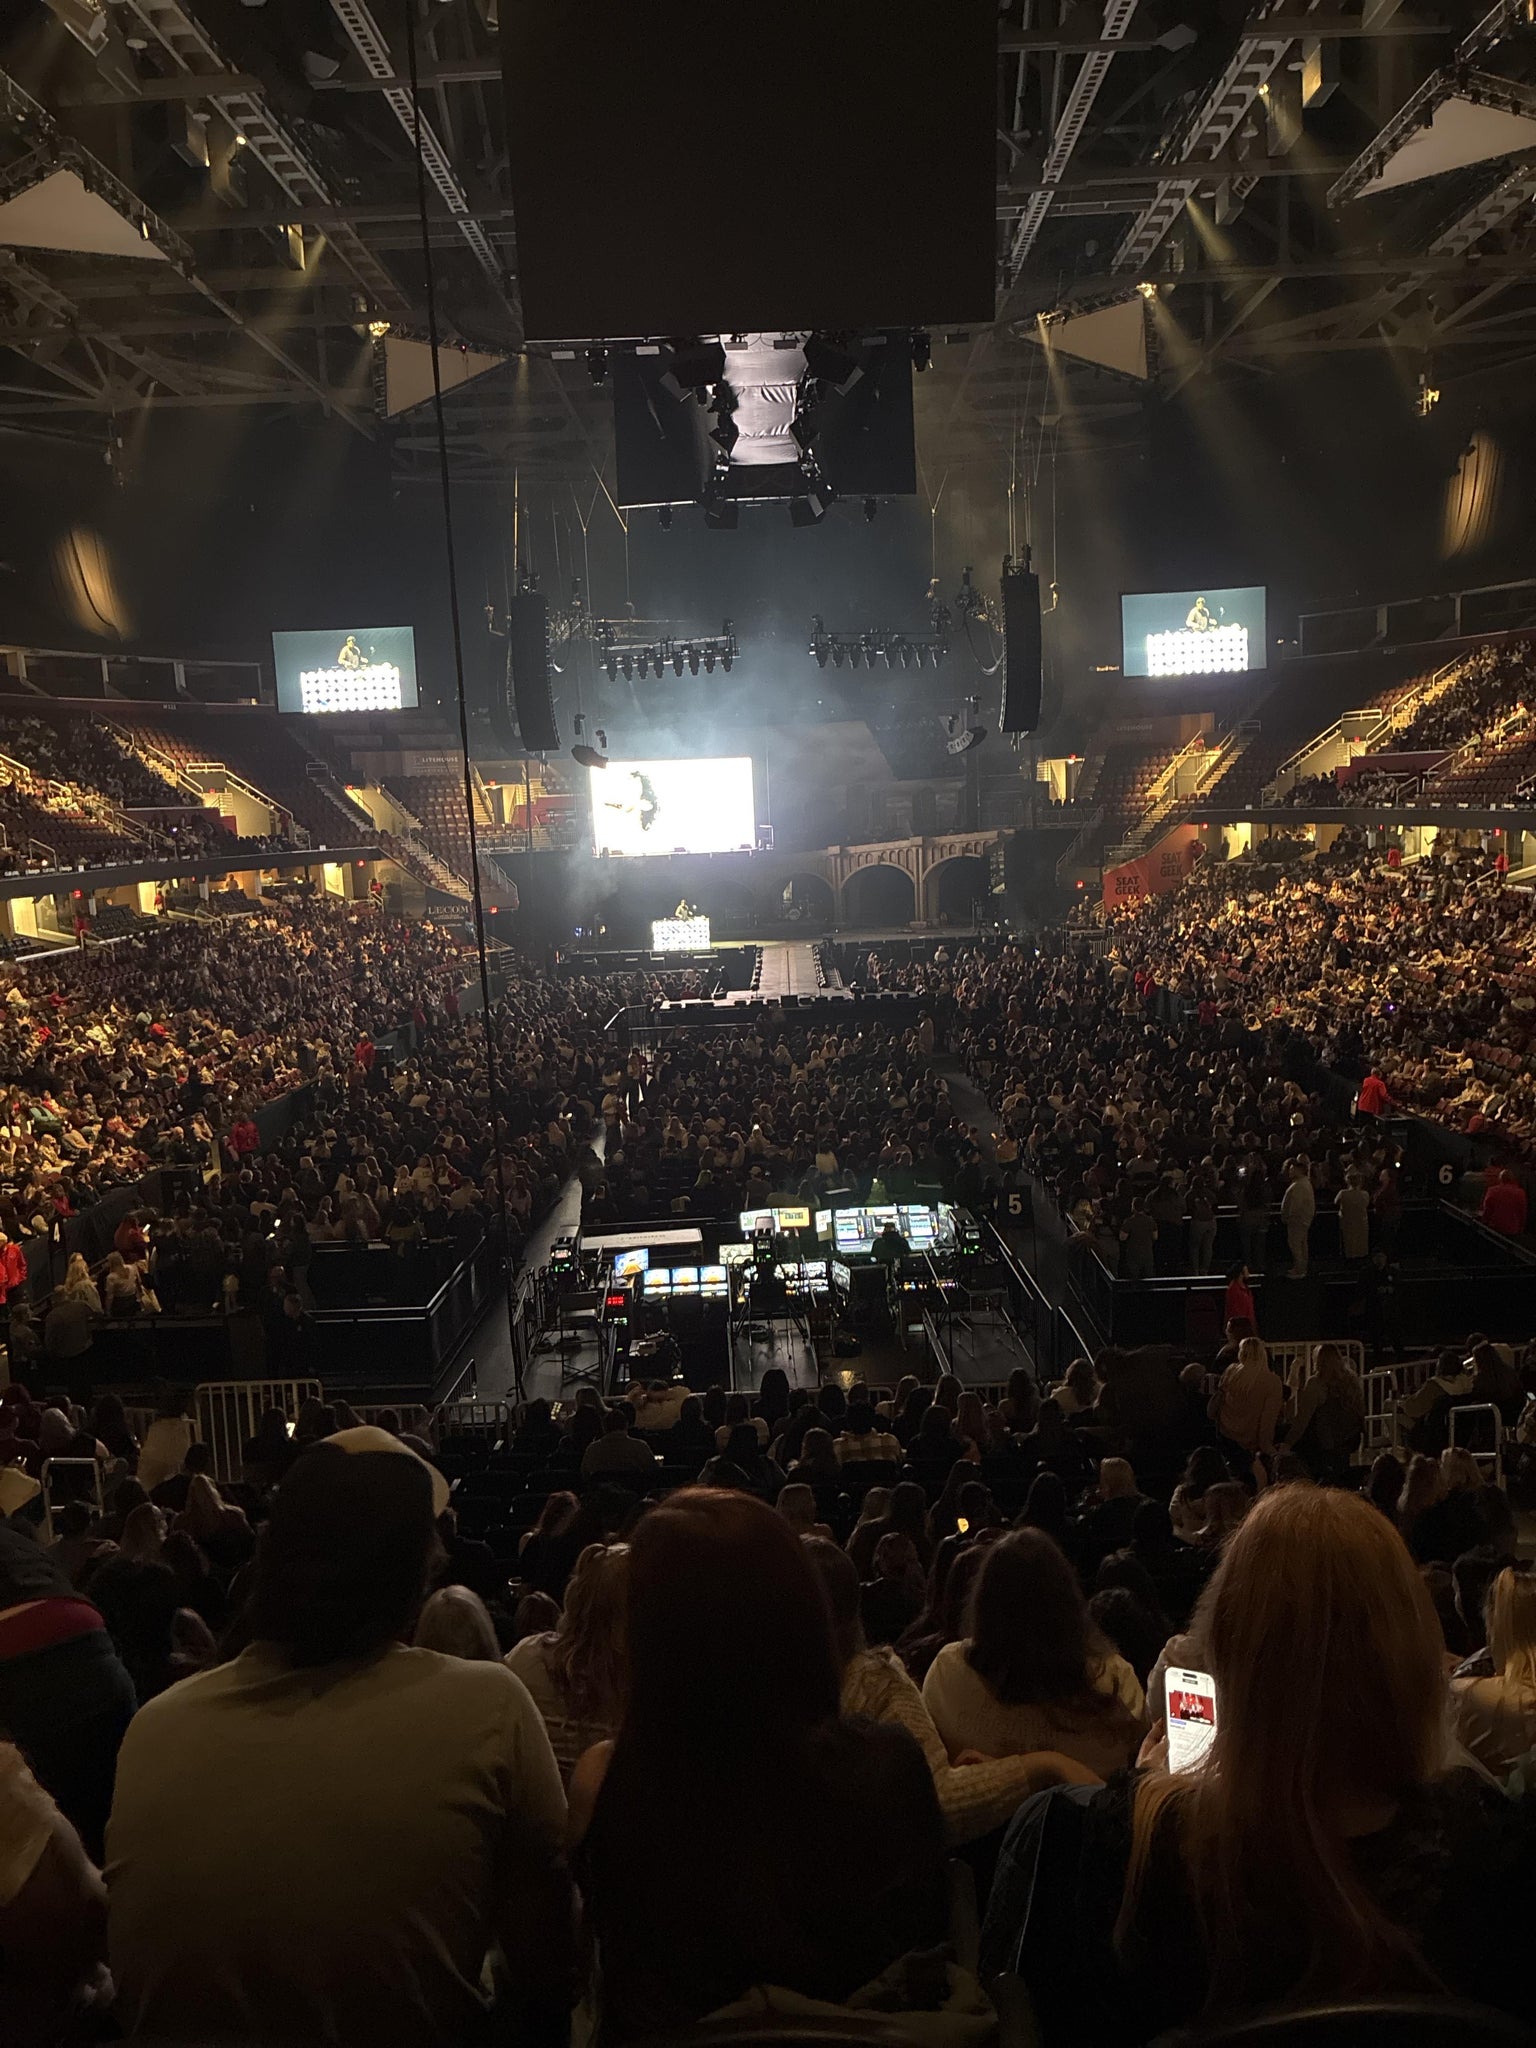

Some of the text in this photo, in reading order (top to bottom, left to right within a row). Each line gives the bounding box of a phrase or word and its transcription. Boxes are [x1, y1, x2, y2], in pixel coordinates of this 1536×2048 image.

[1161, 851, 1183, 864] SEAT
[1160, 864, 1184, 878] GEEK
[1115, 876, 1140, 886] SEAT
[1115, 886, 1141, 896] GEEK
[428, 905, 469, 915] LECOM
[988, 1038, 997, 1051] 3
[381, 1066, 388, 1079] 1
[1439, 1164, 1454, 1185] 6
[1009, 1193, 1022, 1215] 5
